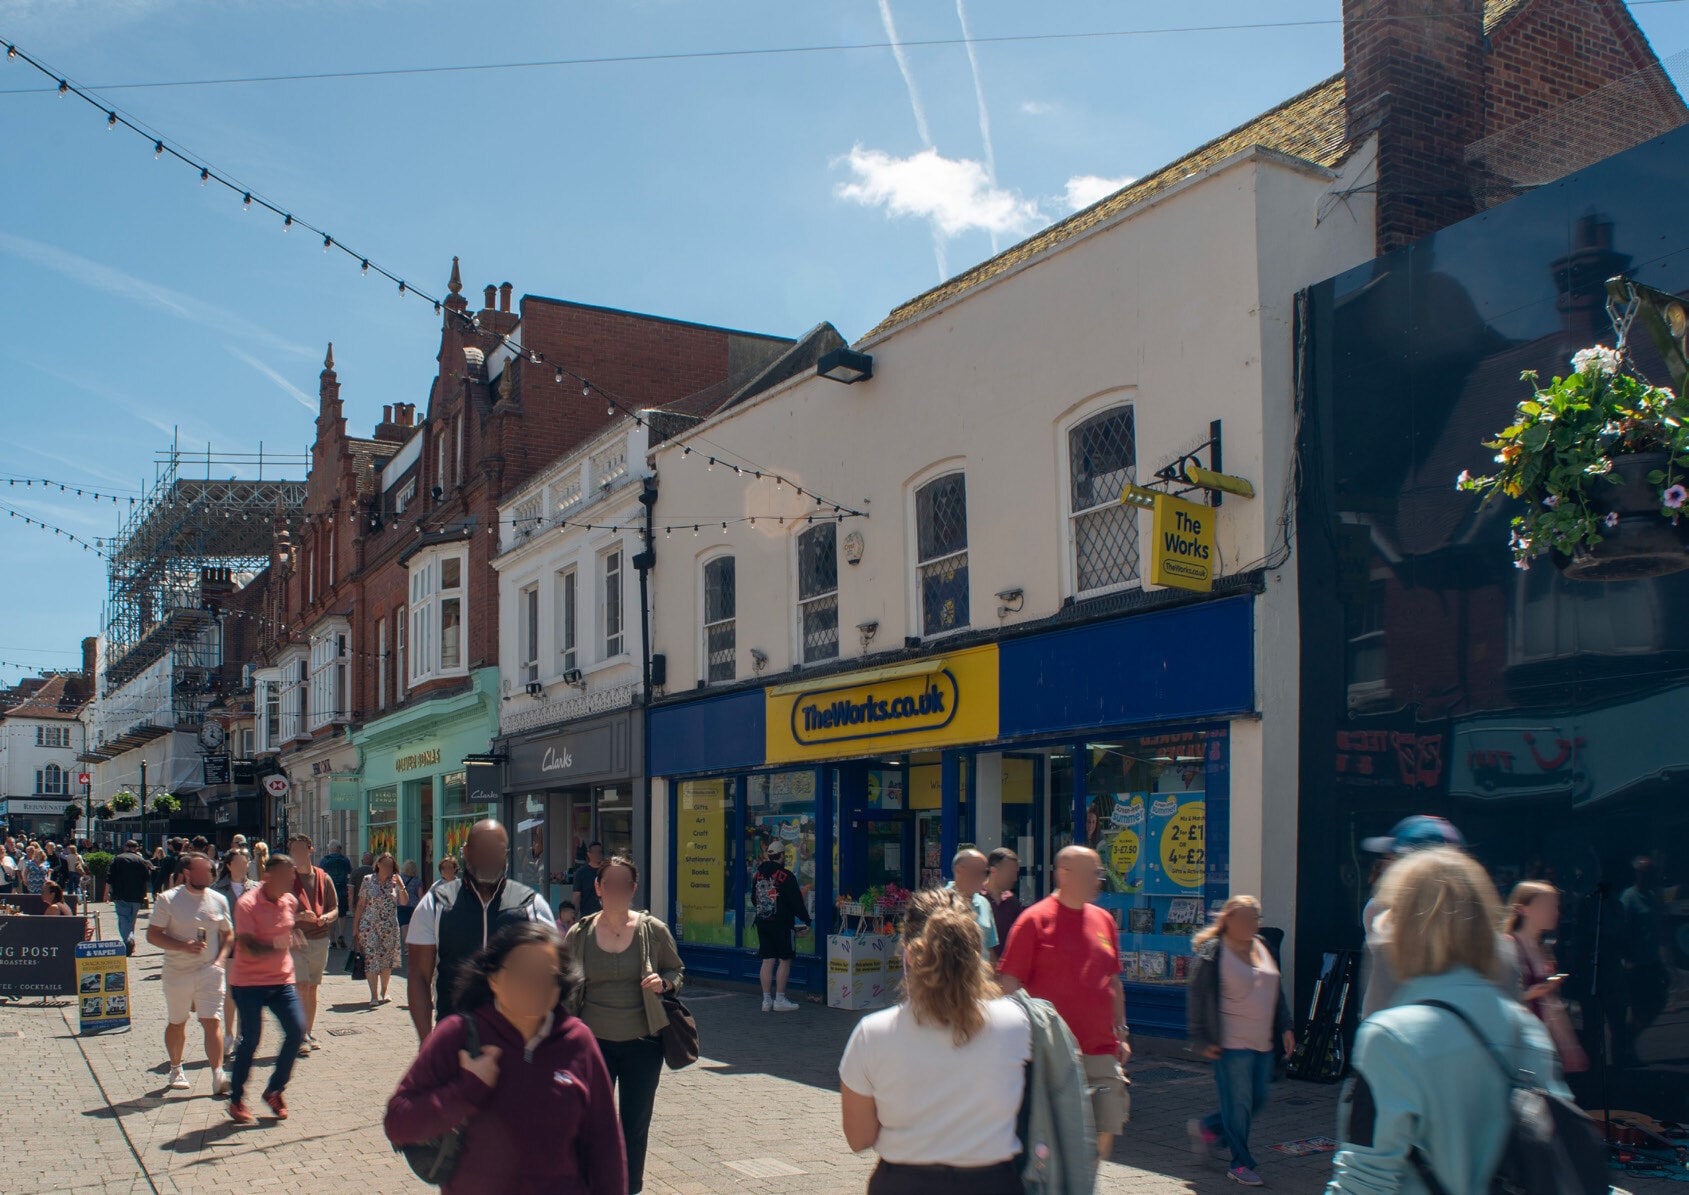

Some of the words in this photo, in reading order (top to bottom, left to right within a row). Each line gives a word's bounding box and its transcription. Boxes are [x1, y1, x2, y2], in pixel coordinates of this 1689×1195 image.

[1175, 511, 1202, 535] The
[1164, 532, 1209, 560] Works
[1166, 562, 1208, 577] TheWorks.co.uk
[802, 684, 945, 732] TheWorks.co.uk
[542, 746, 572, 772] Clarks
[470, 790, 498, 799] Clarks
[1171, 825, 1180, 840] 2
[1169, 849, 1178, 864] 4
[22, 946, 59, 957] POST
